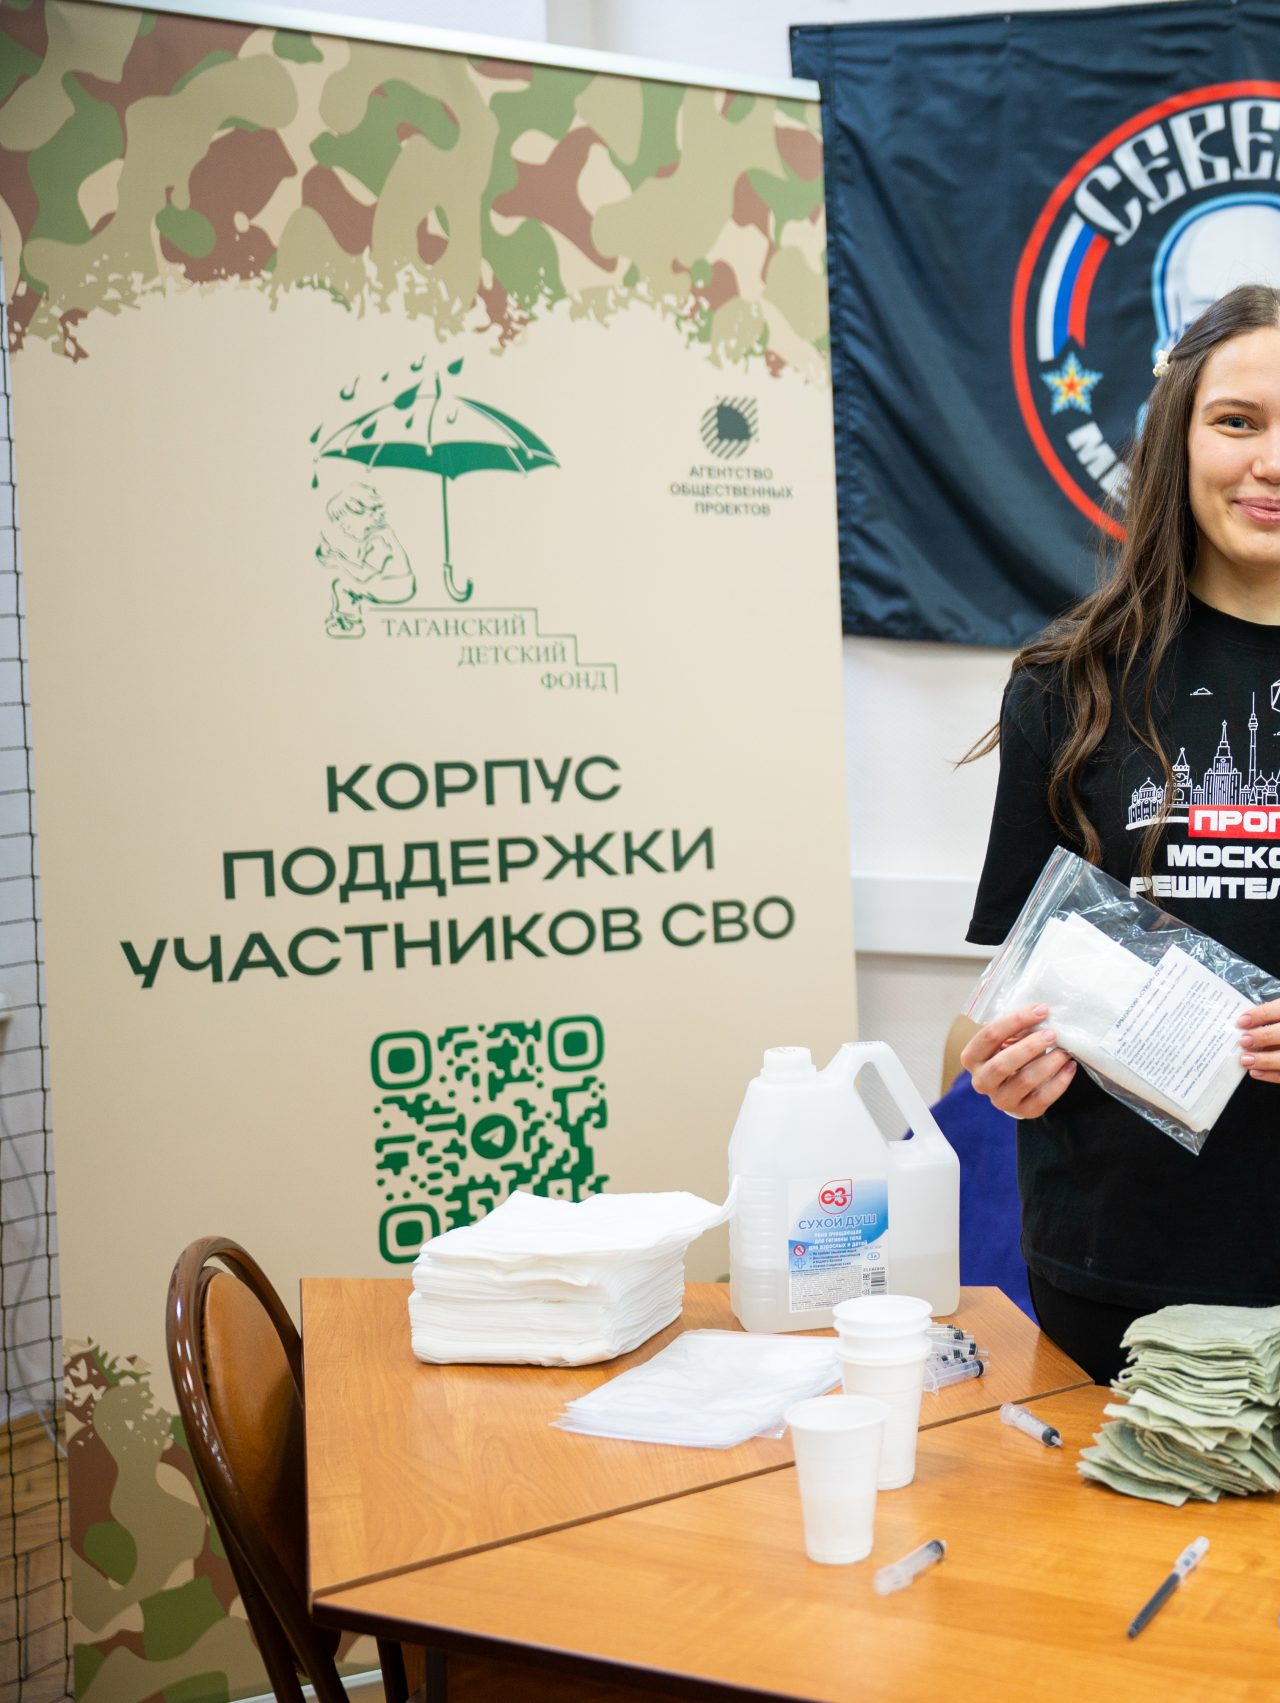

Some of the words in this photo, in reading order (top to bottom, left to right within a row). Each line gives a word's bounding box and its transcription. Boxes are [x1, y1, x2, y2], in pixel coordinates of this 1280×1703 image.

[689, 465, 774, 481] АГЕНТСТВО
[670, 482, 794, 499] ОБЩЕСТВЕННЫХ
[694, 502, 772, 517] ПРОЕКТОВ
[381, 613, 527, 638] ТАГАНСКИЙ
[457, 641, 567, 668] ДЕТСКИЙ
[540, 671, 608, 691] ФОНД
[325, 755, 623, 814] КОРПУС
[222, 826, 716, 904] ПОДДЕРЖКИ
[118, 905, 643, 990] УЧАСТНИКОВ
[661, 895, 797, 949] СВО
[798, 1216, 843, 1230] СУХОЙ
[845, 1213, 877, 1228] ДУШ
